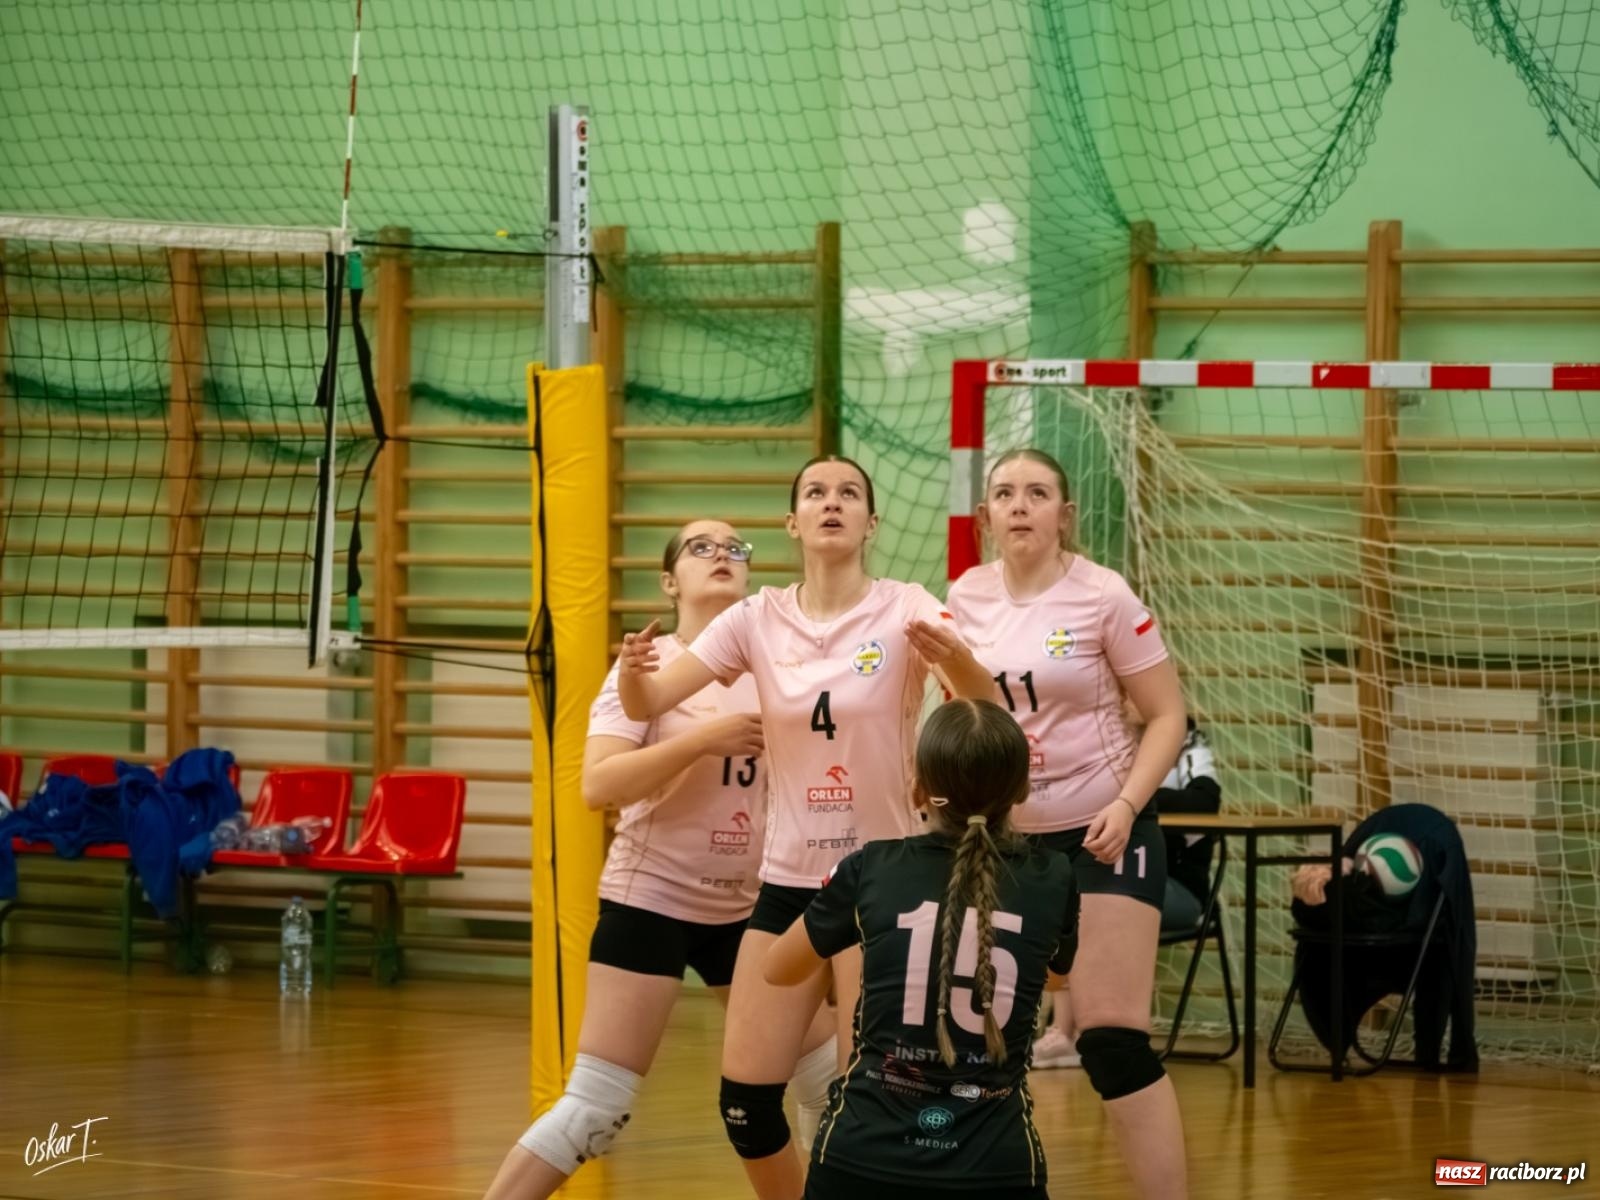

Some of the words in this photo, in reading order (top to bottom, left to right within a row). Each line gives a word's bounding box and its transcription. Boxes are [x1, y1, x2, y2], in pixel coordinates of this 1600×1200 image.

[1033, 366, 1066, 381] sport
[994, 671, 1038, 712] 11
[811, 691, 837, 740] 4
[722, 755, 757, 788] 13
[809, 788, 850, 801] ORLEN
[897, 900, 1023, 1035] 15
